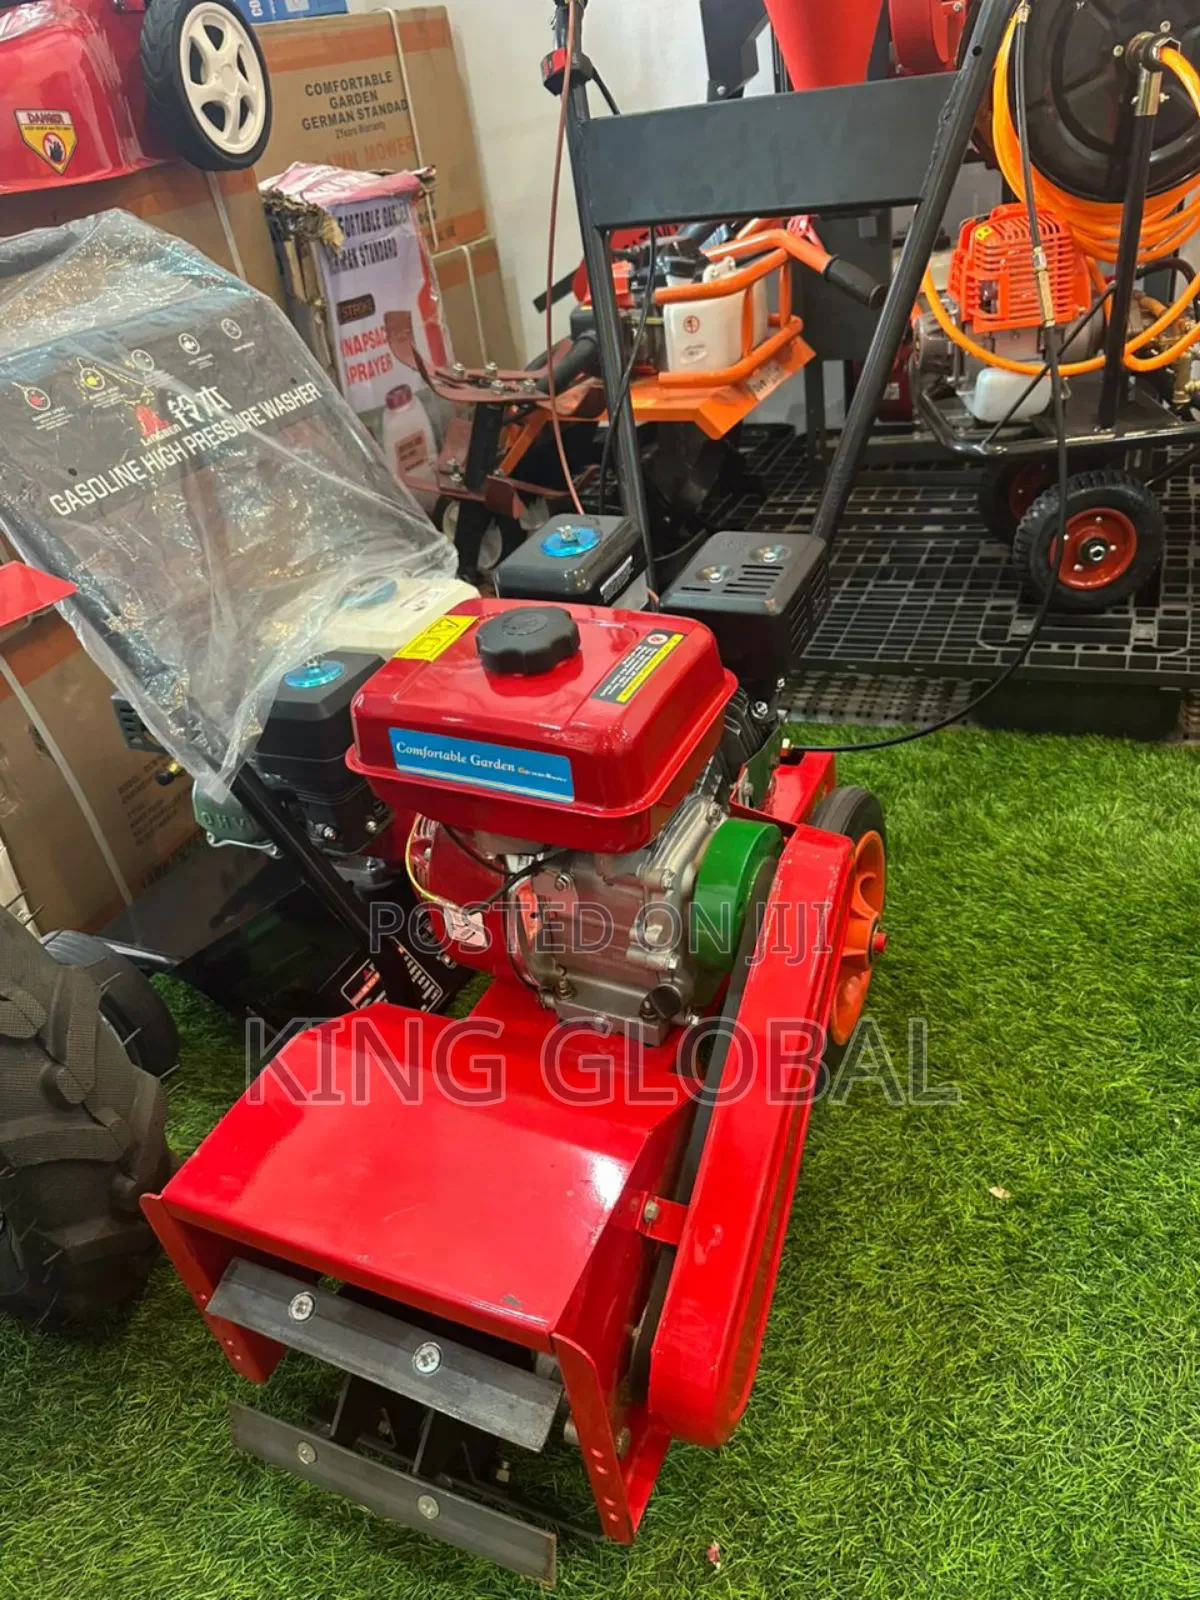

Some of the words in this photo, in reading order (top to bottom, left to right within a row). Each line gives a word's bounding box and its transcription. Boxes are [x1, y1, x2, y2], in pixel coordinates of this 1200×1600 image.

[305, 71, 393, 97] COMFORTABLE
[329, 90, 379, 109] GARDEN
[27, 112, 65, 124] DANGER
[301, 110, 355, 131] GERMAN
[324, 150, 358, 168] AWN
[360, 237, 398, 267] STANDARD
[50, 459, 148, 516] GASOLINE
[139, 441, 188, 478] HIGH
[182, 406, 266, 455] PRESSURE
[257, 382, 323, 427] WASHER
[396, 741, 467, 764] Comfortable
[469, 754, 515, 772] Garden
